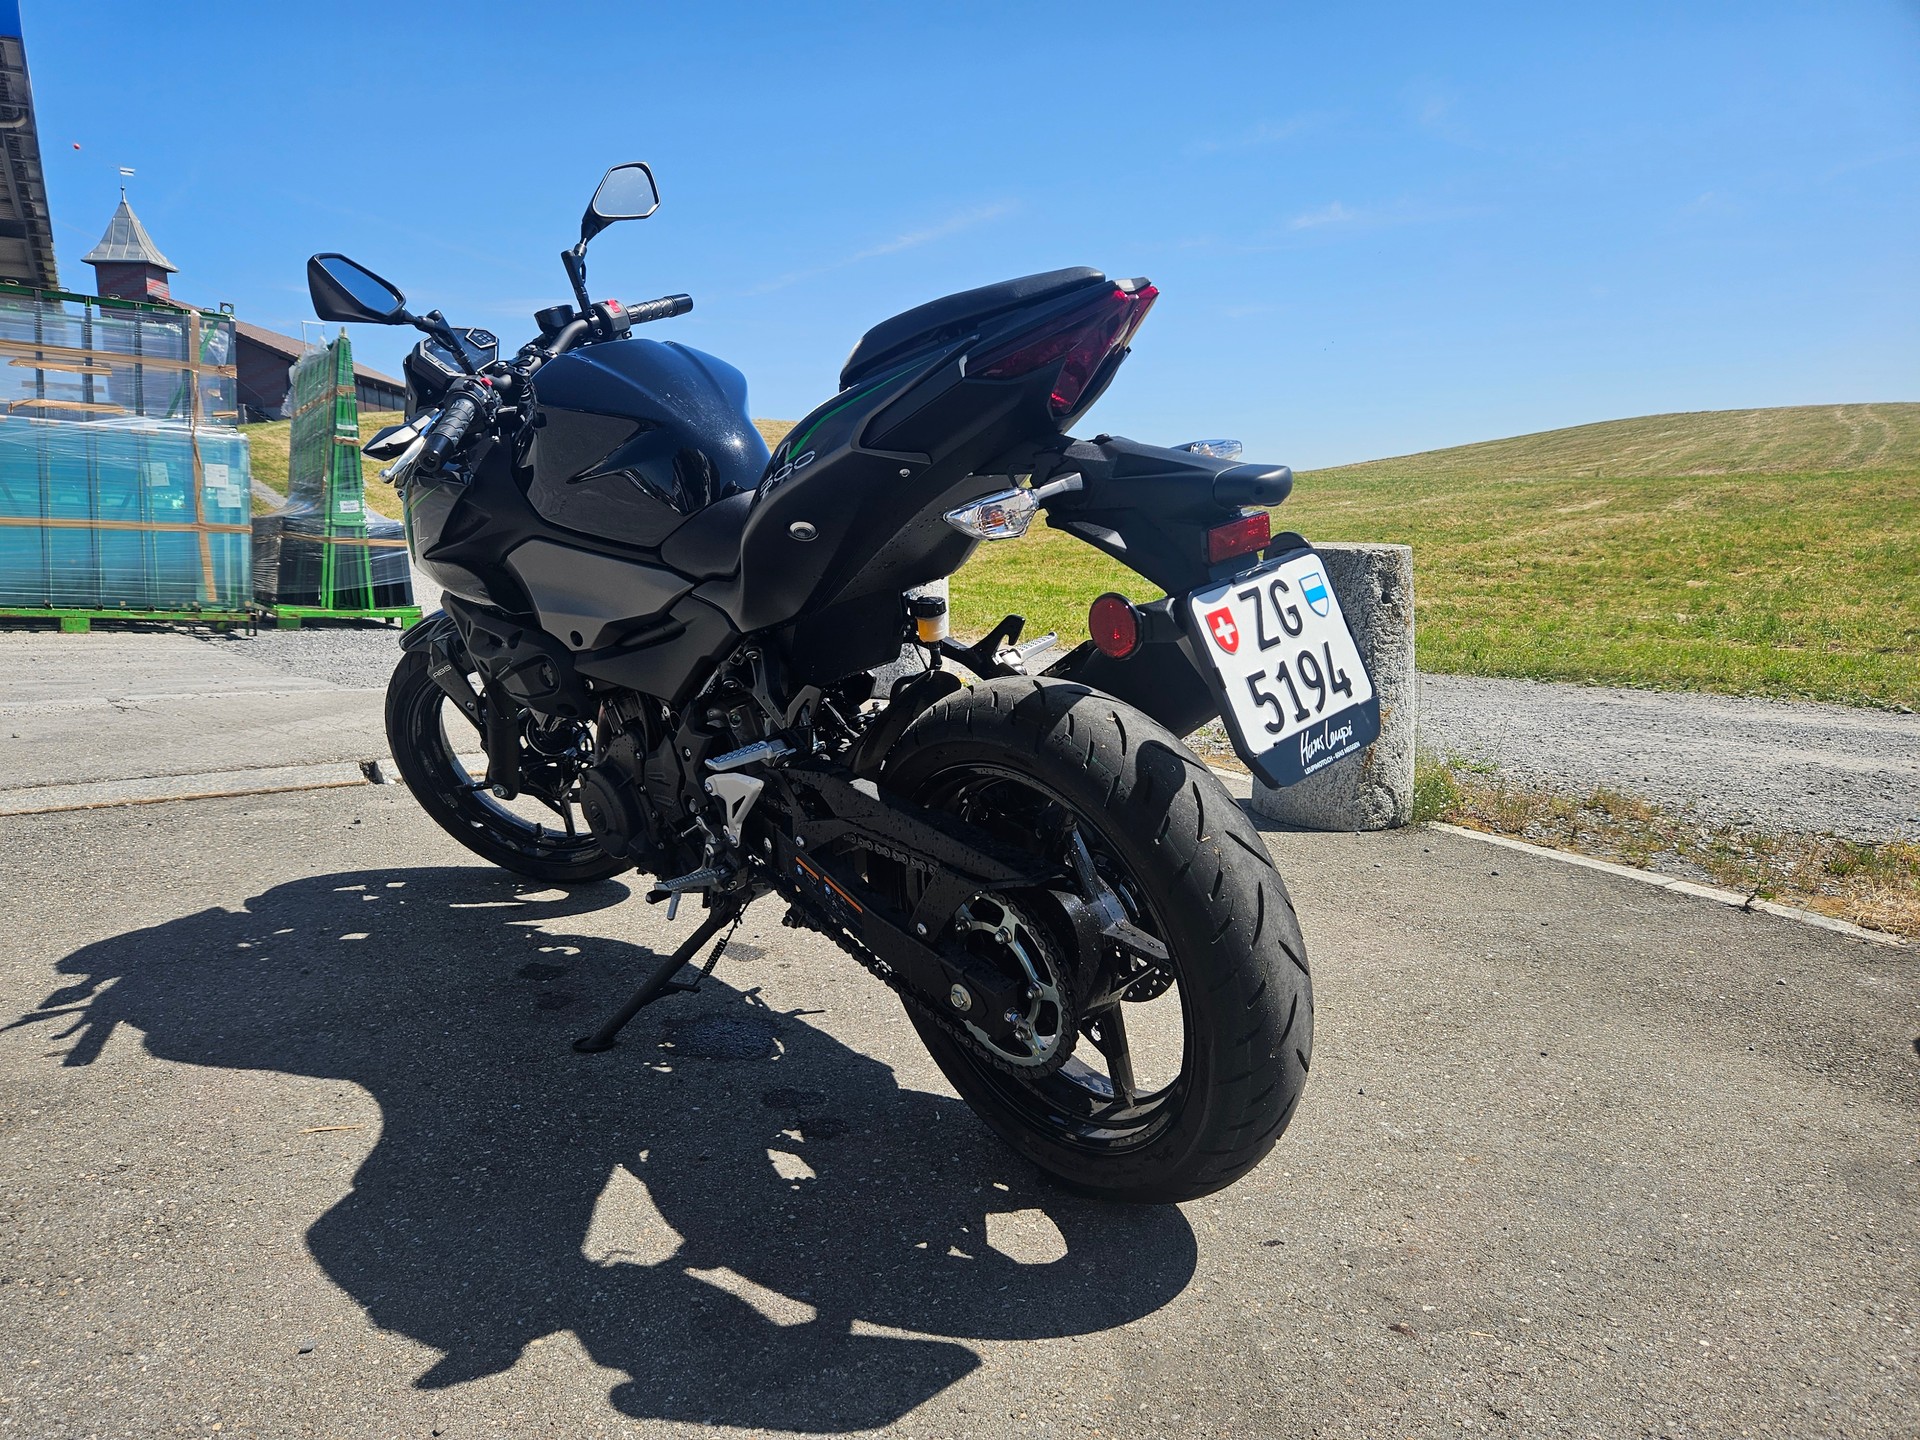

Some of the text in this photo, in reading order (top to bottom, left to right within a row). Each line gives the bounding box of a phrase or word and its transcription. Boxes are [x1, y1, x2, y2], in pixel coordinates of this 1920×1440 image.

[1238, 579, 1304, 651] ZG
[1246, 641, 1353, 733] 5194
[1300, 719, 1353, 767] Hans Leupi
